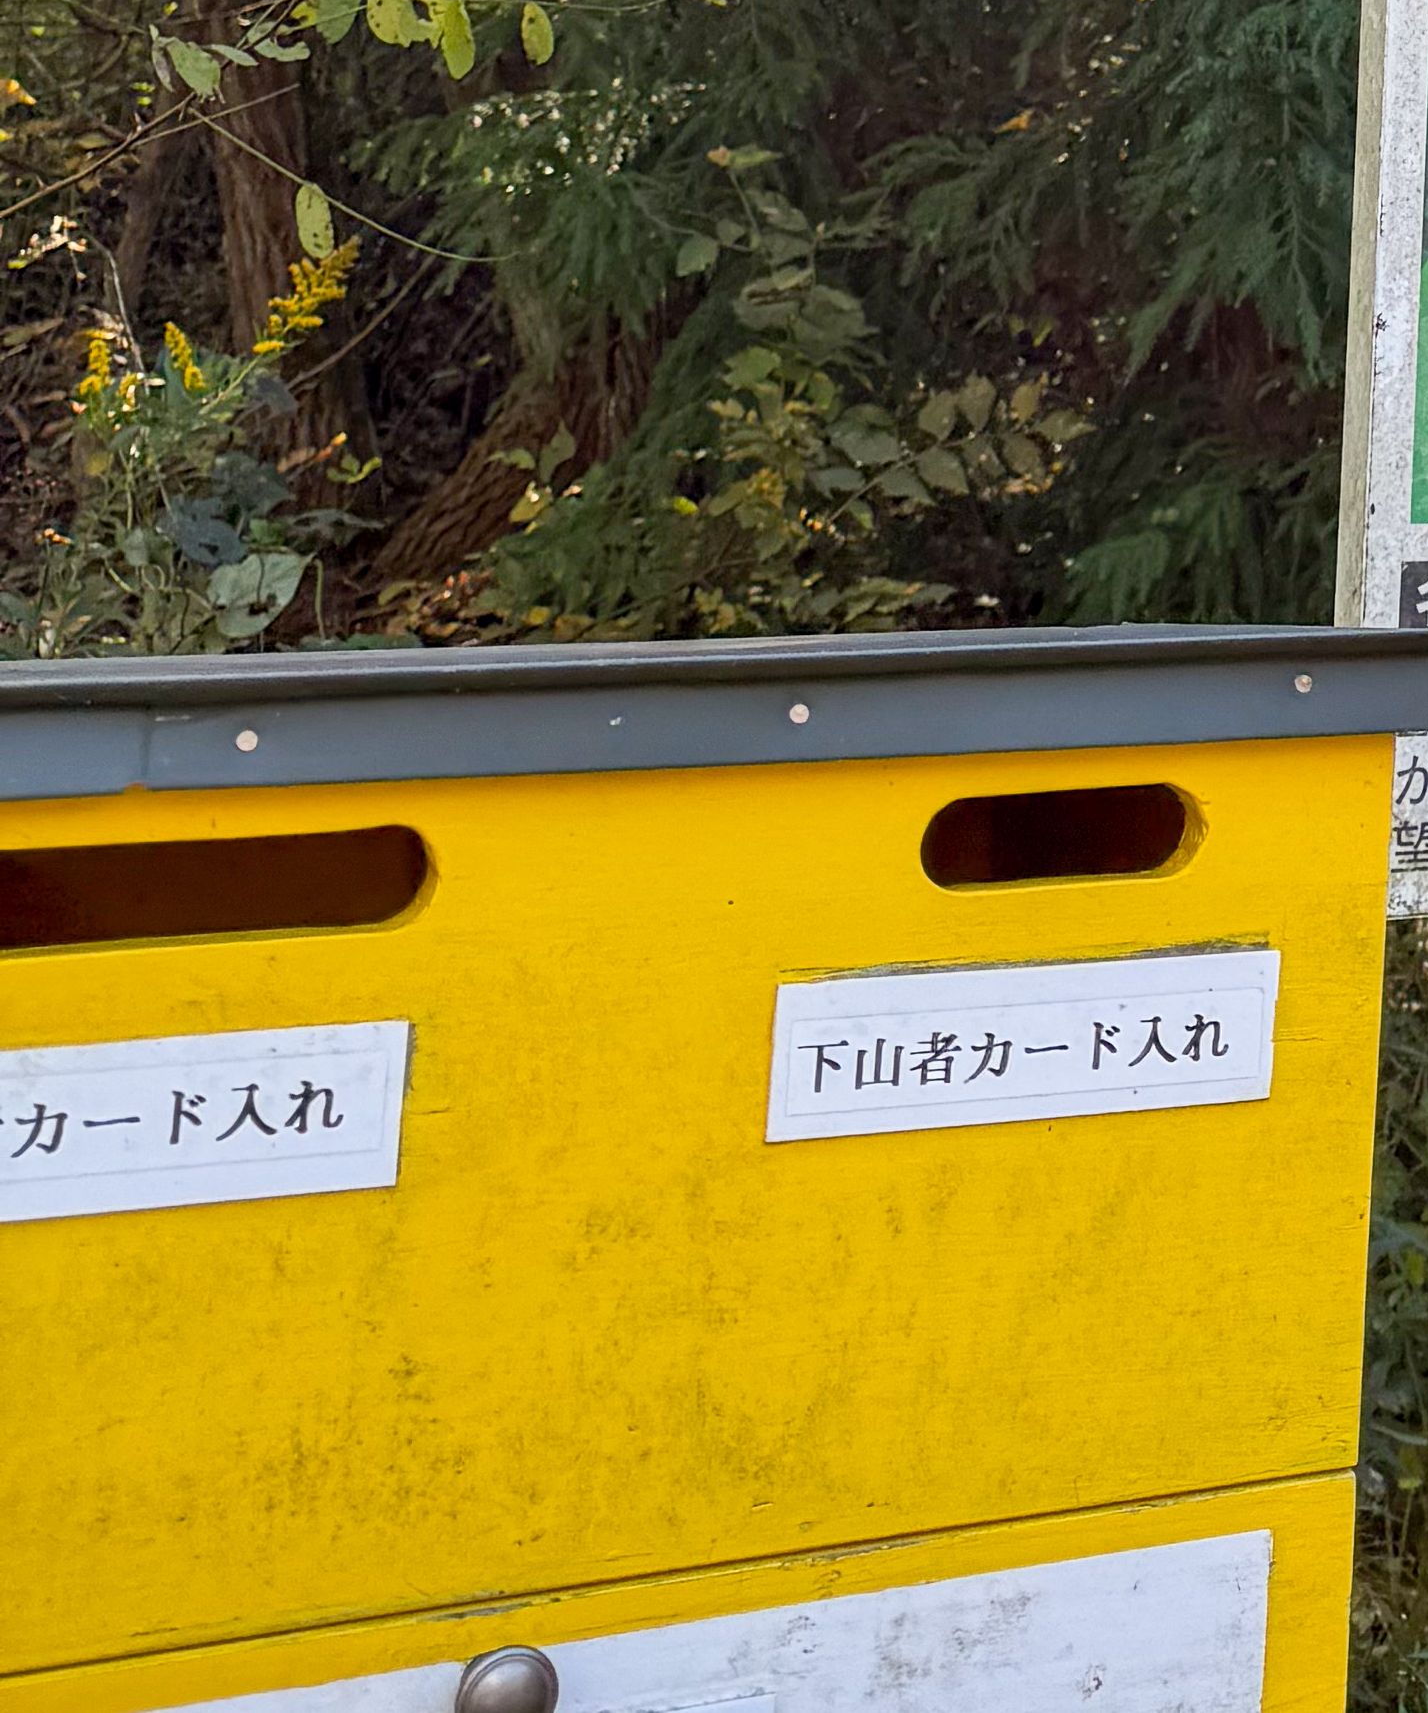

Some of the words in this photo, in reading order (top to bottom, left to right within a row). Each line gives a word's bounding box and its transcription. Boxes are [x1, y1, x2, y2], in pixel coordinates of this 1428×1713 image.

[797, 1013, 1229, 1094] 下山者カード入れ
[0, 1080, 344, 1159] カード入れ
